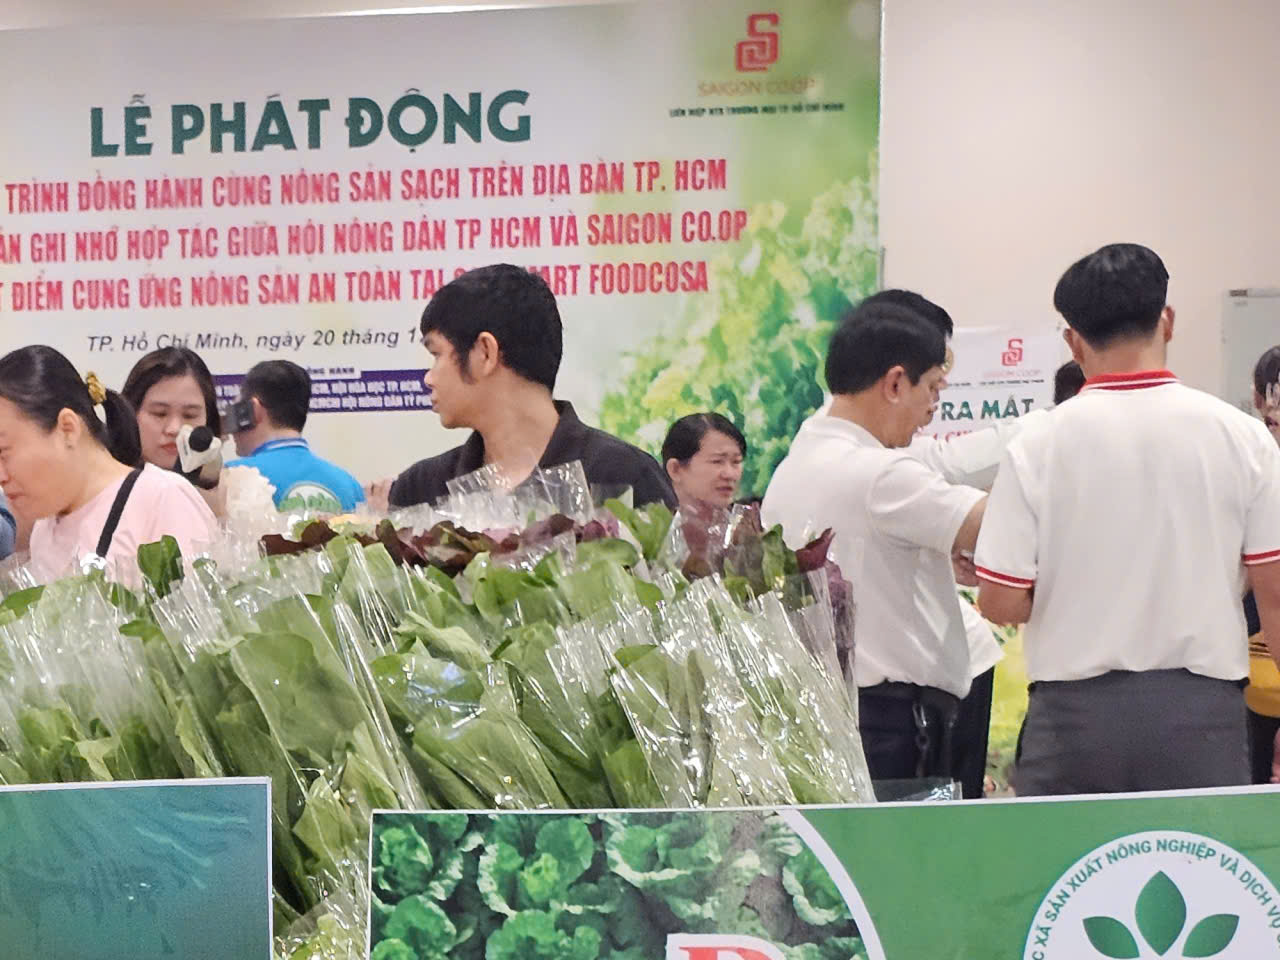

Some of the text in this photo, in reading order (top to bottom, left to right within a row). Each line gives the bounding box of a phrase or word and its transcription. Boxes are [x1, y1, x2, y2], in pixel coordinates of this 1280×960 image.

[91, 87, 532, 157] LỄ PHÁT ĐỘNG
[5, 176, 69, 215] TRÌNH
[77, 170, 137, 212] ĐỒNG
[145, 173, 204, 210] HÀNH
[212, 170, 272, 208] CÙNG
[280, 167, 341, 205] NÔNG
[349, 163, 392, 203] SẢN
[400, 167, 460, 206] SẠCH
[468, 160, 523, 198] TRÊN
[532, 163, 571, 202] ĐỊA
[579, 157, 625, 195] BÀN
[633, 160, 667, 193] TP.
[675, 158, 727, 191] HCM
[29, 232, 67, 264] GHI
[75, 225, 119, 262] NHỚ
[127, 224, 170, 266] HỢP
[178, 221, 219, 259] TÁC
[227, 220, 280, 257] GIỮA
[287, 218, 325, 262] HỘI
[334, 216, 394, 254] NÔNG
[403, 214, 447, 252] DÂN
[455, 218, 482, 250] TP
[491, 215, 542, 249] HCM
[550, 209, 579, 247] VÀ
[587, 211, 673, 246] SAIGON
[681, 209, 748, 243] CO.OP
[12, 268, 65, 312] ĐIỂM
[72, 277, 131, 311] CUNG
[138, 272, 183, 308] ỨNG
[191, 270, 250, 308] NÔNG
[258, 265, 301, 305] SẢN
[308, 271, 337, 304] AN
[345, 265, 402, 303] TOÀN
[589, 260, 709, 295] FOODCOSA
[88, 334, 115, 352] TP.
[122, 330, 149, 351] Hồ
[156, 332, 190, 350] Chí
[195, 332, 249, 351] Minh,
[256, 332, 306, 352] ngày
[313, 329, 336, 347] 20
[342, 328, 400, 349] tháng
[941, 392, 1035, 421] RA MẮT
[1034, 924, 1053, 948] XÃ
[1044, 889, 1071, 923] SẢN
[1065, 856, 1104, 893] XUẤT
[1106, 839, 1152, 865] NÔNG
[1156, 839, 1217, 862] NGHIỆP
[1219, 853, 1240, 876] VÀ
[1239, 869, 1273, 907] DỊCH
